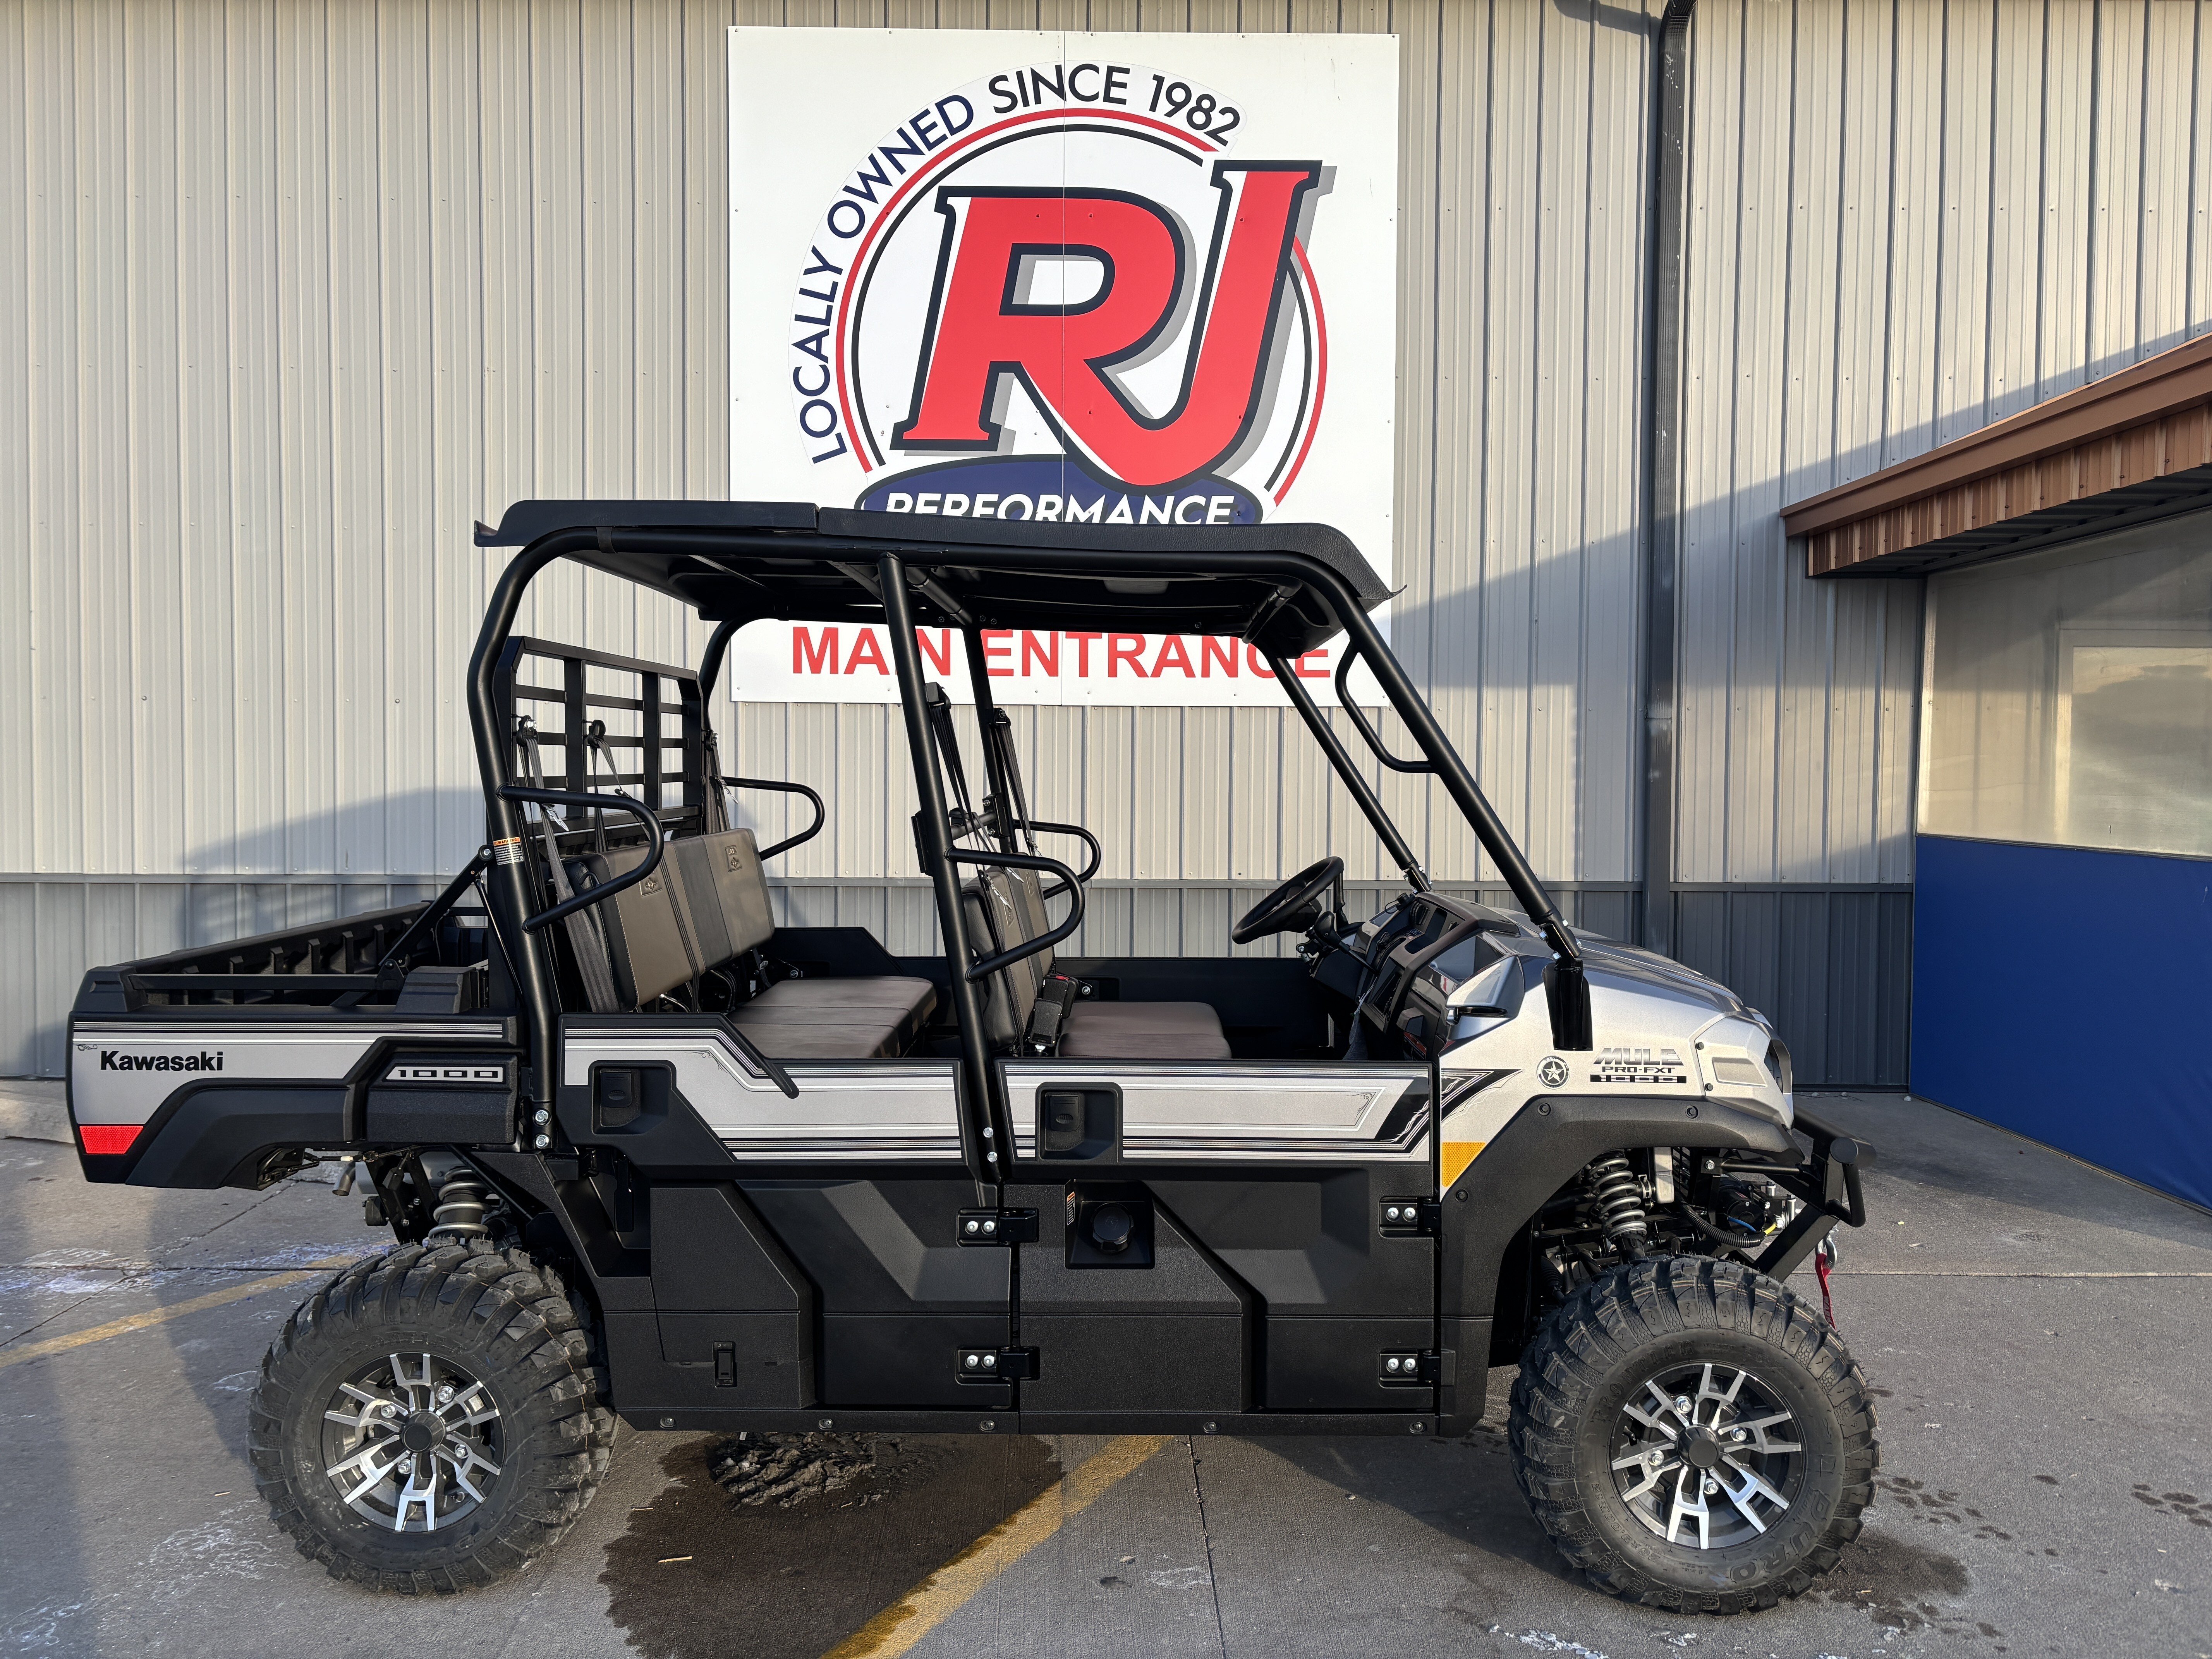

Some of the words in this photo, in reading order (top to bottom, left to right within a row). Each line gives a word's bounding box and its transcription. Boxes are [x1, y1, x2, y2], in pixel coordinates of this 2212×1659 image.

[792, 245, 848, 464] LOCALLY
[827, 94, 974, 239] OWNED
[988, 64, 1130, 113] SINCE
[1149, 74, 1240, 147] 1982
[890, 160, 1323, 494] RJ
[886, 492, 1235, 524] PERFORMANCE
[793, 627, 950, 676] MAN
[100, 1051, 223, 1071] Kawasaki
[398, 1070, 498, 1078] 1000
[1593, 1048, 1684, 1066] MULE
[1729, 1489, 1831, 1583] DURO
